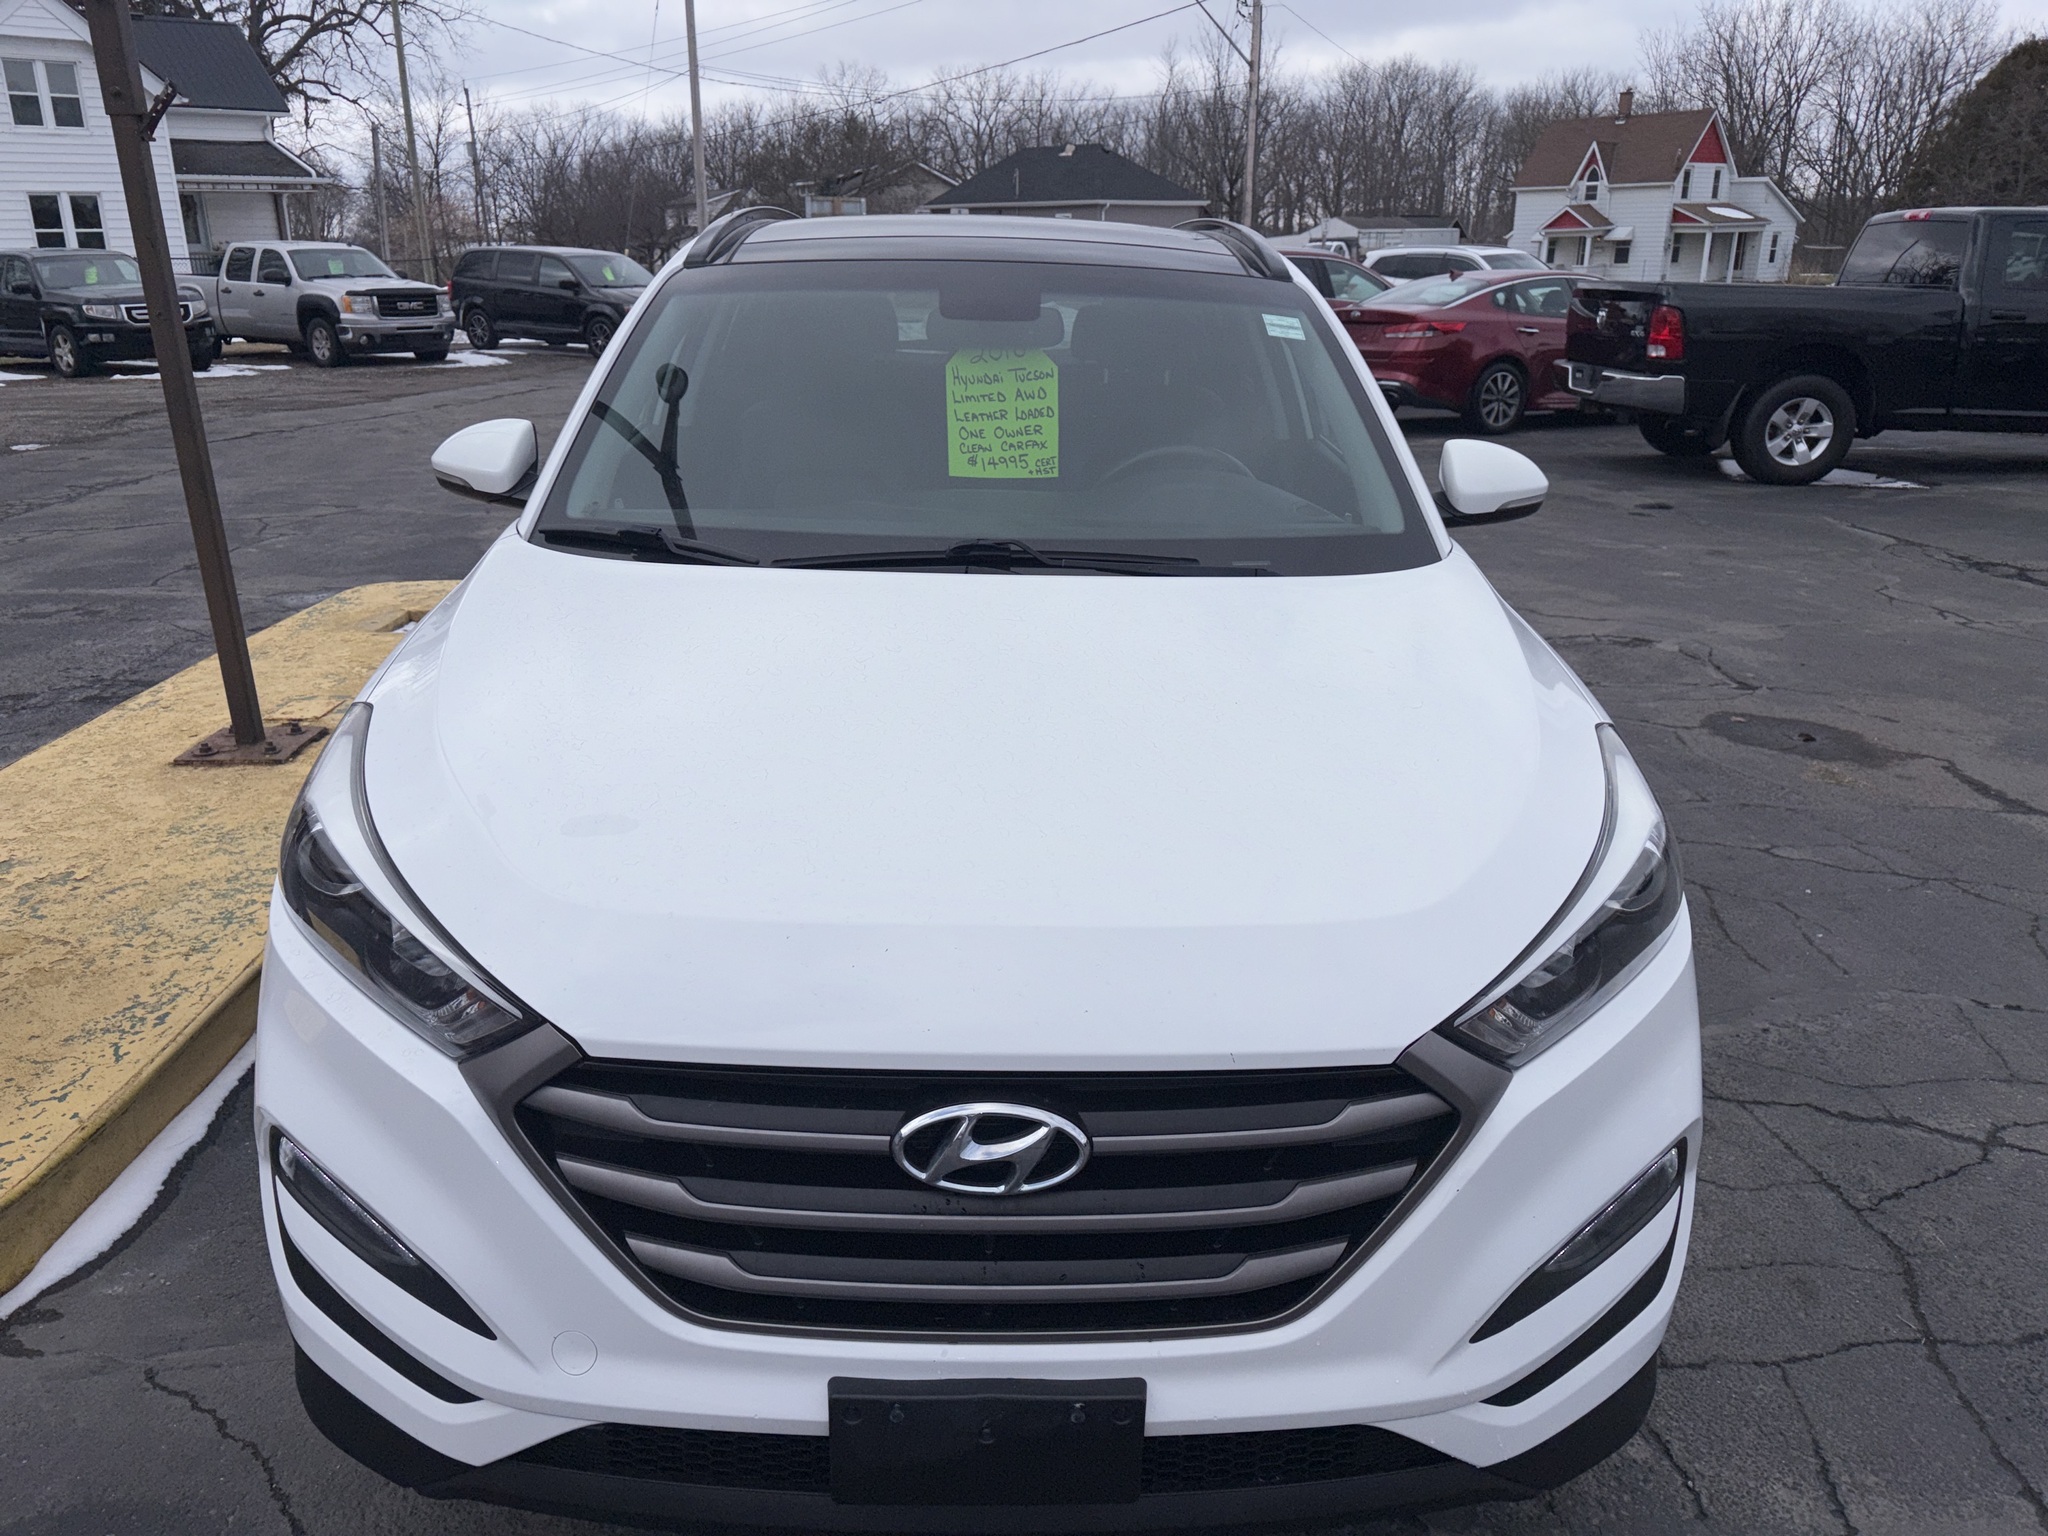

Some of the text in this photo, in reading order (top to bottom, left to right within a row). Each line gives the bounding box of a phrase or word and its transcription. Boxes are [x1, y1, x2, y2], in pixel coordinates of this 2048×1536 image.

[1007, 367, 1055, 383] TUCSON
[952, 386, 1048, 404] LIMITED AWD
[953, 406, 1055, 422] LEATHER LOADED
[958, 424, 1044, 440] ONE OWNER
[959, 440, 1048, 454] CLEAN CARFAX
[967, 453, 1057, 472] $14995 CERT
